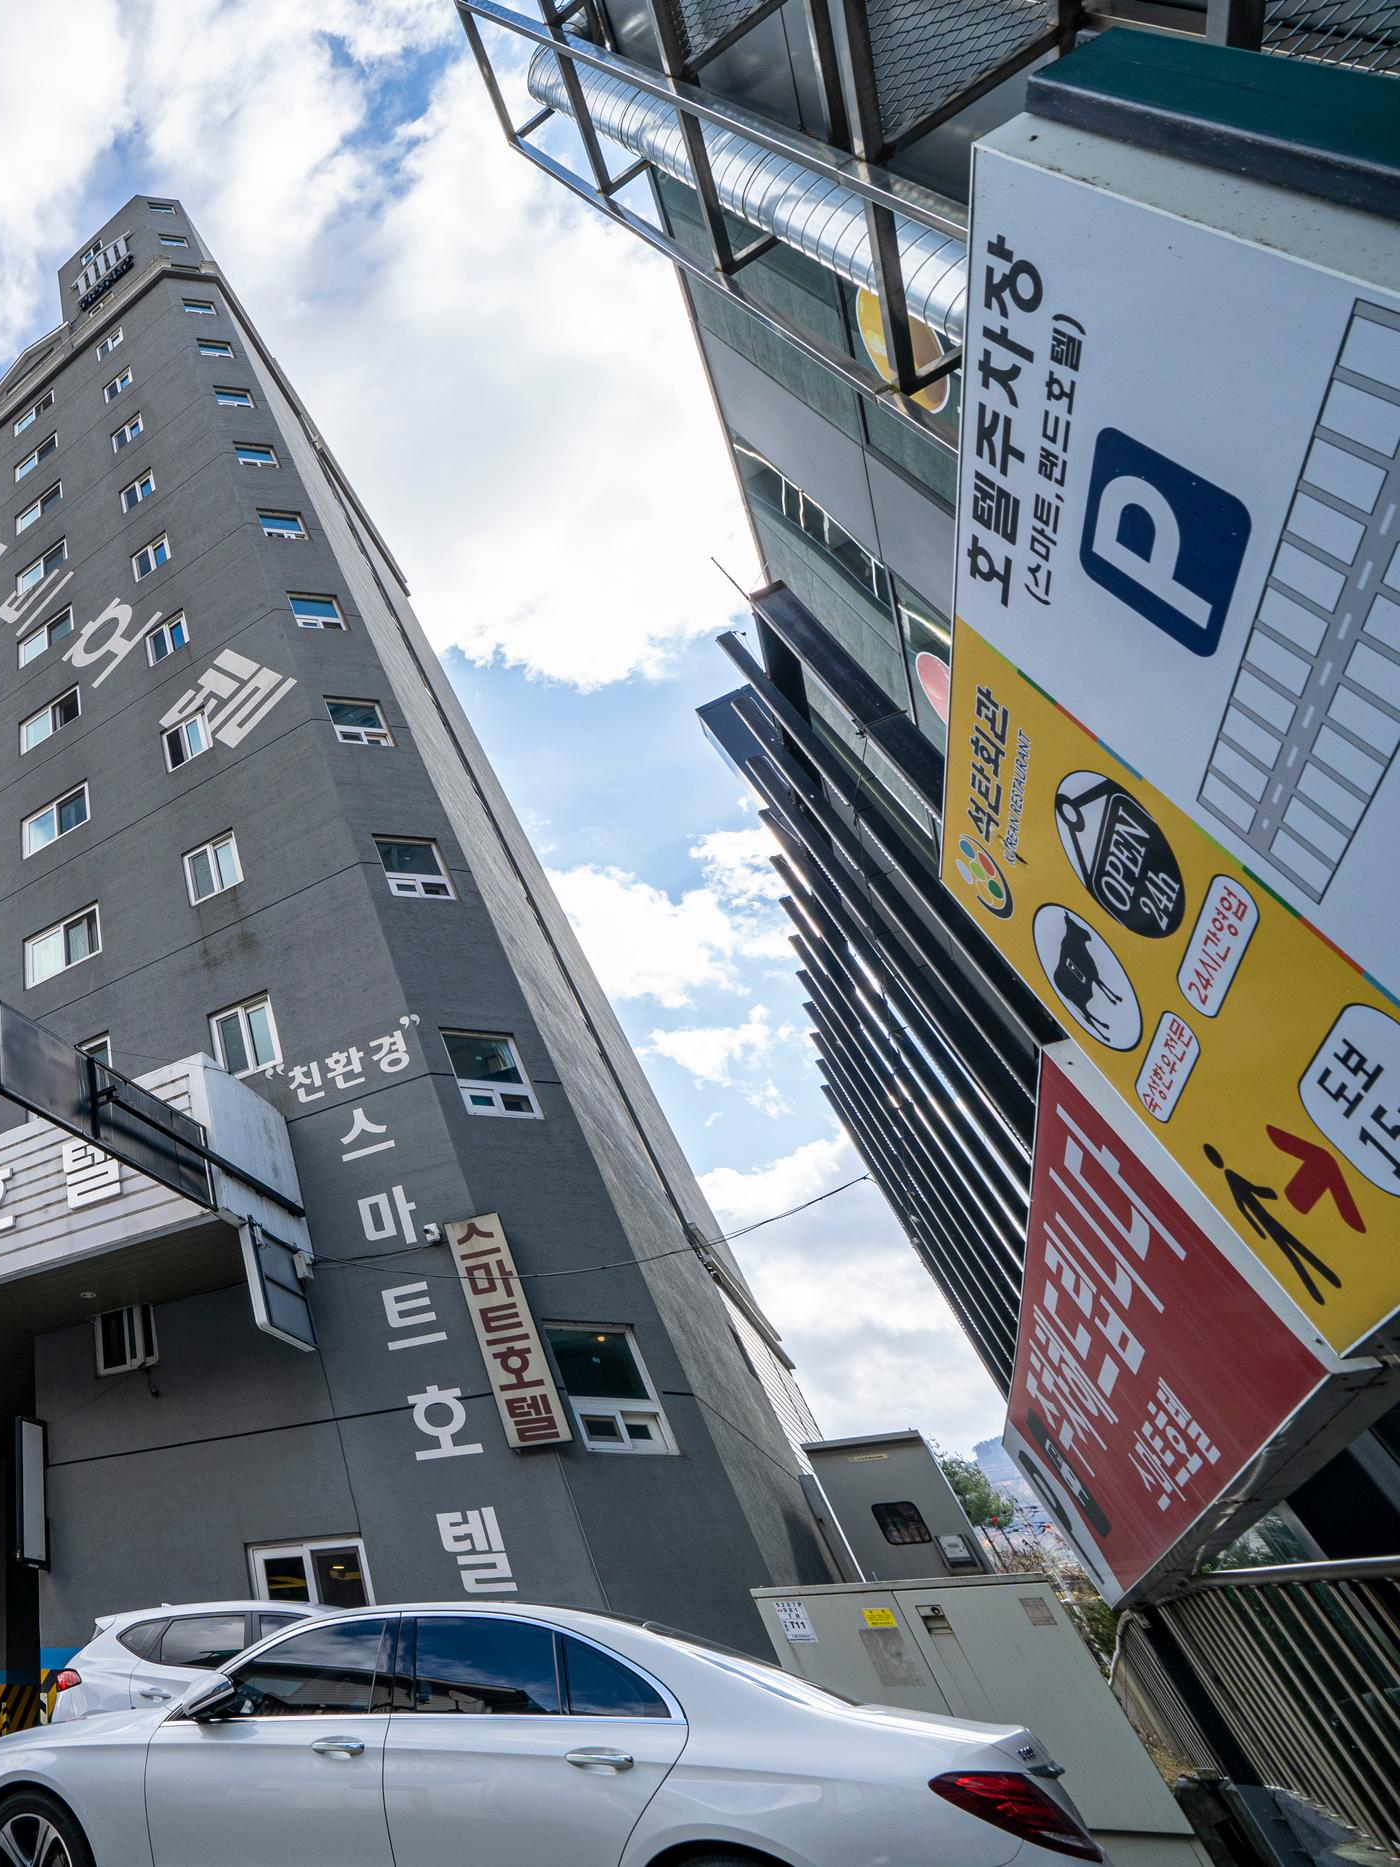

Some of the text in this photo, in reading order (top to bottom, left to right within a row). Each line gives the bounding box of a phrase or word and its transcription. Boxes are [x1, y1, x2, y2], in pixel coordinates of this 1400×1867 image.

[967, 234, 1043, 607] 호텔주차장
[1092, 475, 1213, 630] P
[966, 685, 1010, 843] 석탄회관
[1010, 728, 1032, 817] RESTAURANT
[1101, 807, 1151, 912] OPEN
[1141, 870, 1180, 932] 24h
[1188, 886, 1248, 1005] 24시간영업
[1142, 1018, 1193, 1114] 숙성한우전문
[1317, 1038, 1384, 1119] 도보
[1359, 1104, 1400, 1181] 15
[340, 1107, 518, 1594] 스마트호텔
[456, 1220, 562, 1444] 스마트호텔
[1026, 1103, 1187, 1478] 주차해드립니다
[1128, 1376, 1222, 1511] 스마트호텔
